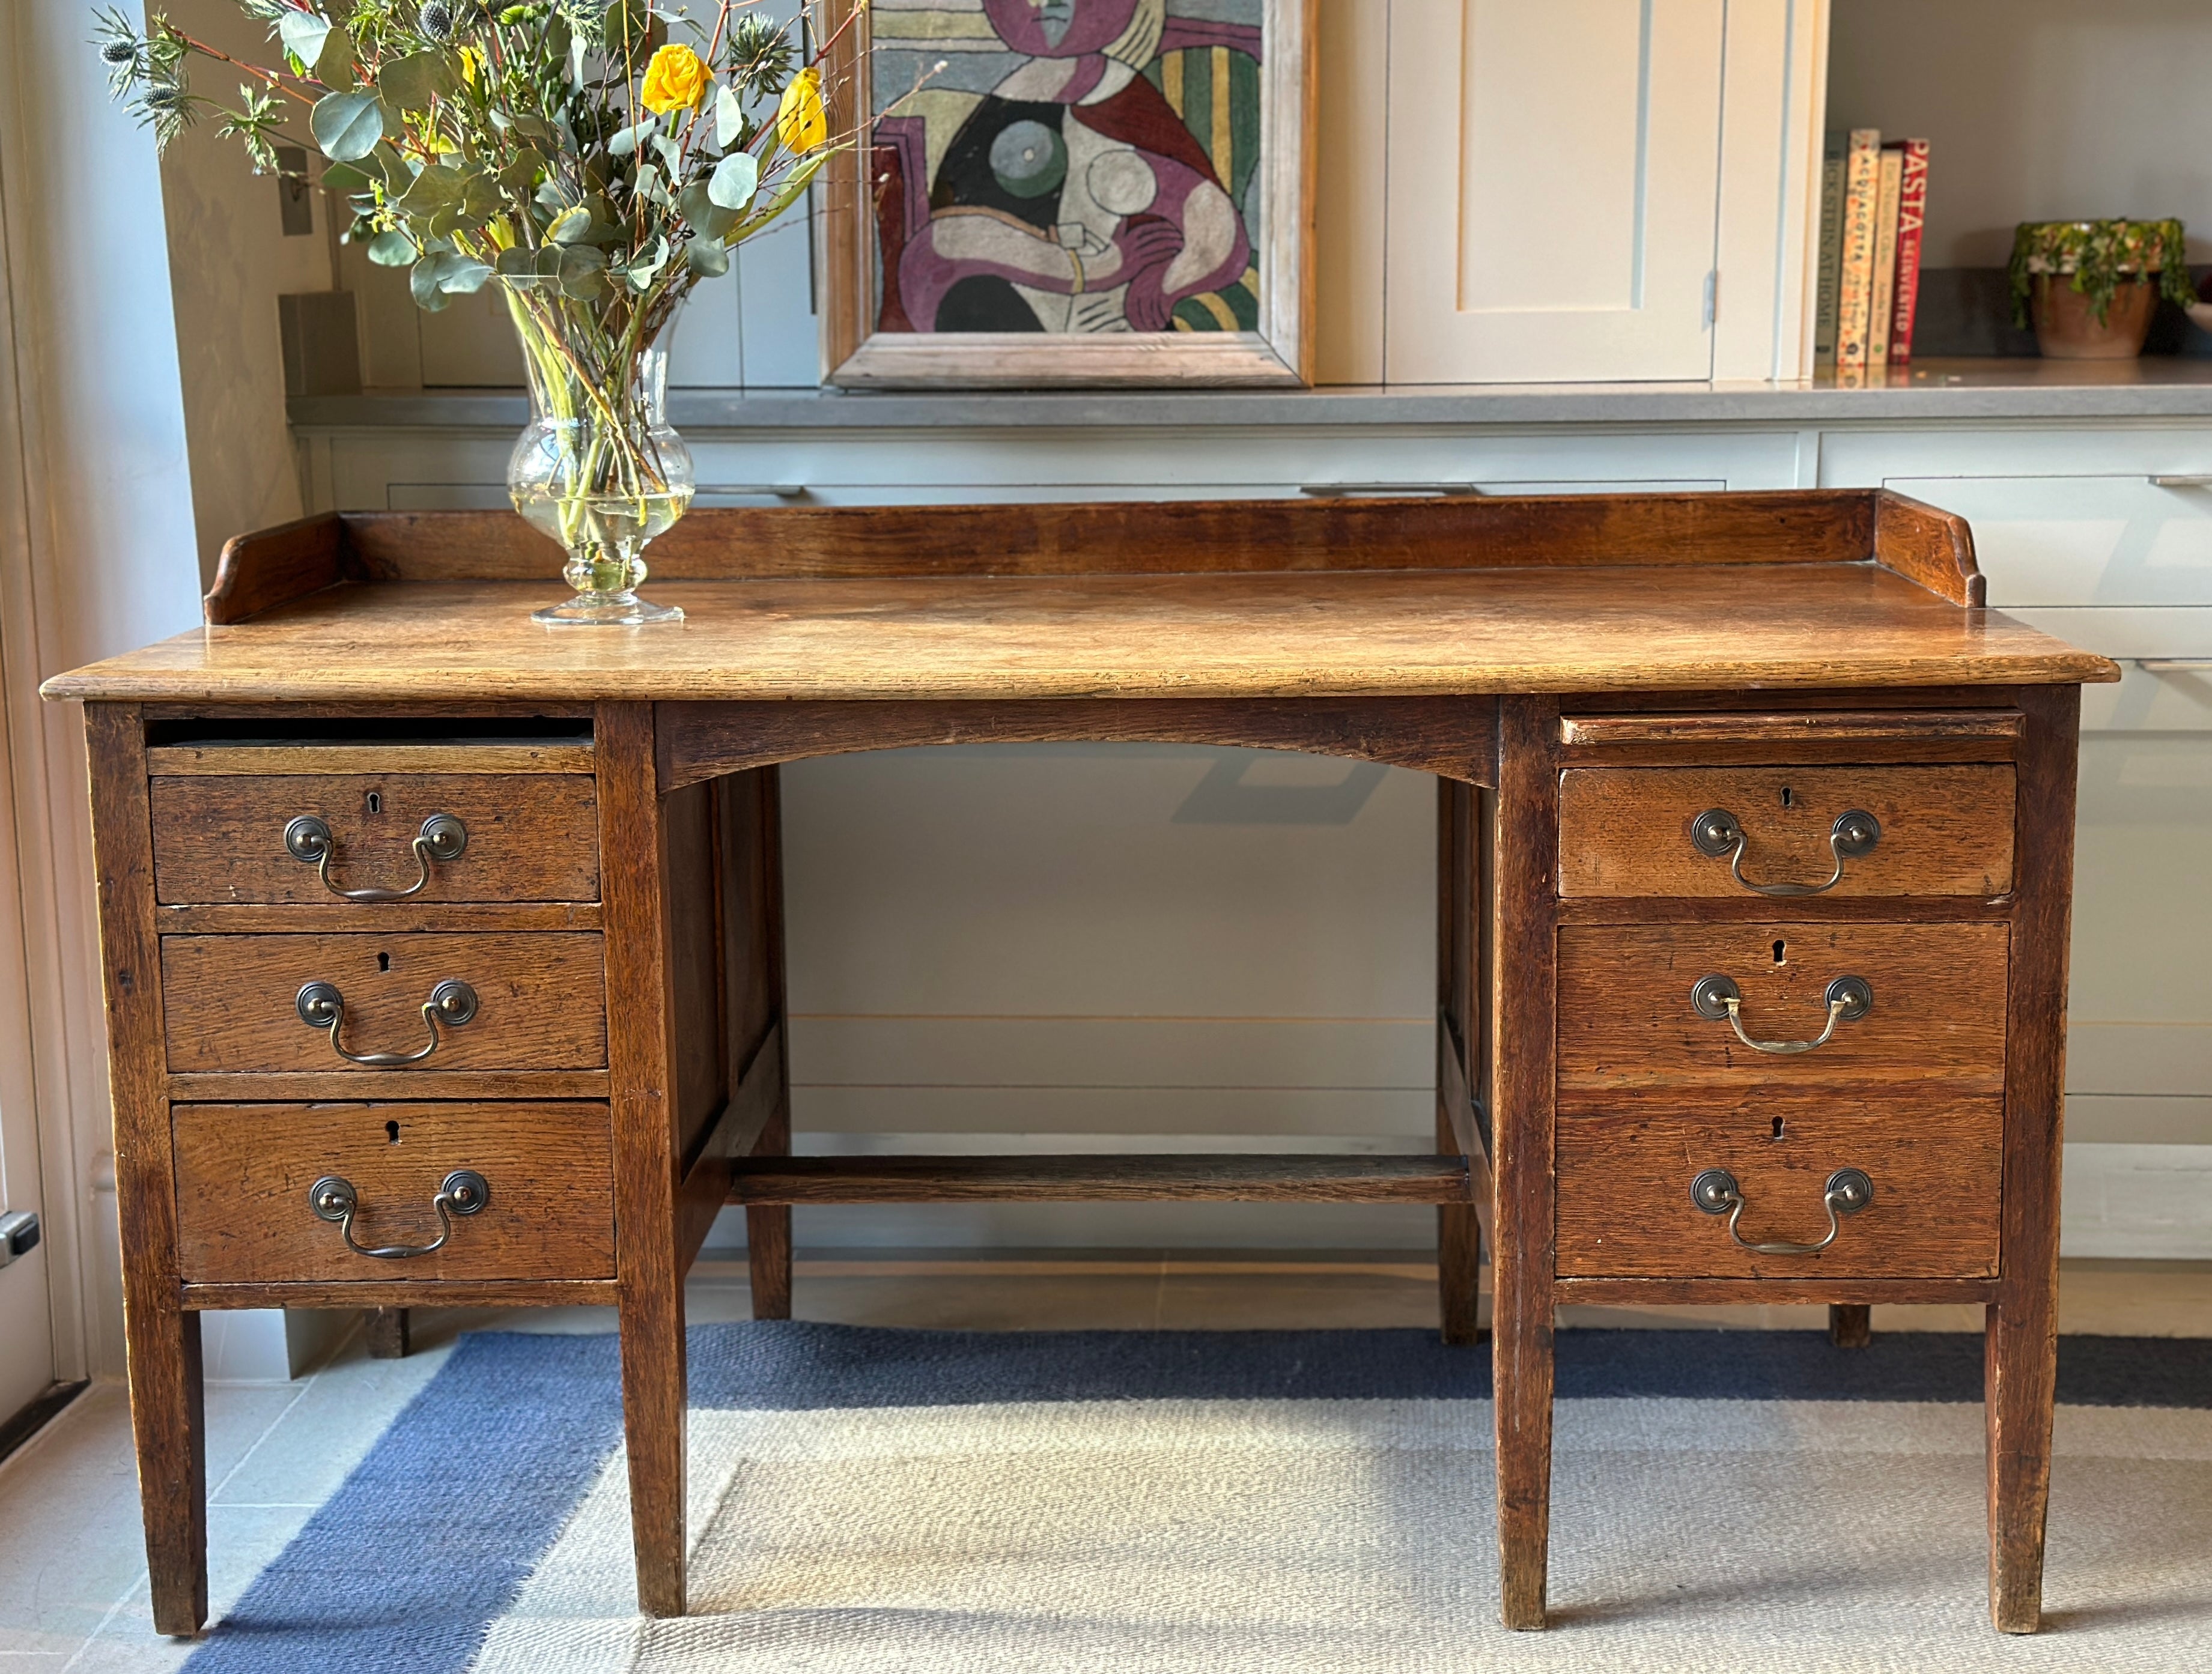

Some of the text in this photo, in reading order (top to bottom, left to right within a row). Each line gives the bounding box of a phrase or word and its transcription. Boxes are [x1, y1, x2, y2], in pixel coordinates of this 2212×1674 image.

[1822, 195, 1837, 246] STEIN
[1854, 157, 1870, 261] ACQUACOTTA
[1899, 138, 1930, 233] PASTA
[1820, 252, 1834, 274] AT
[1895, 240, 1915, 332] REINVENTED
[1818, 277, 1833, 327] HOME
